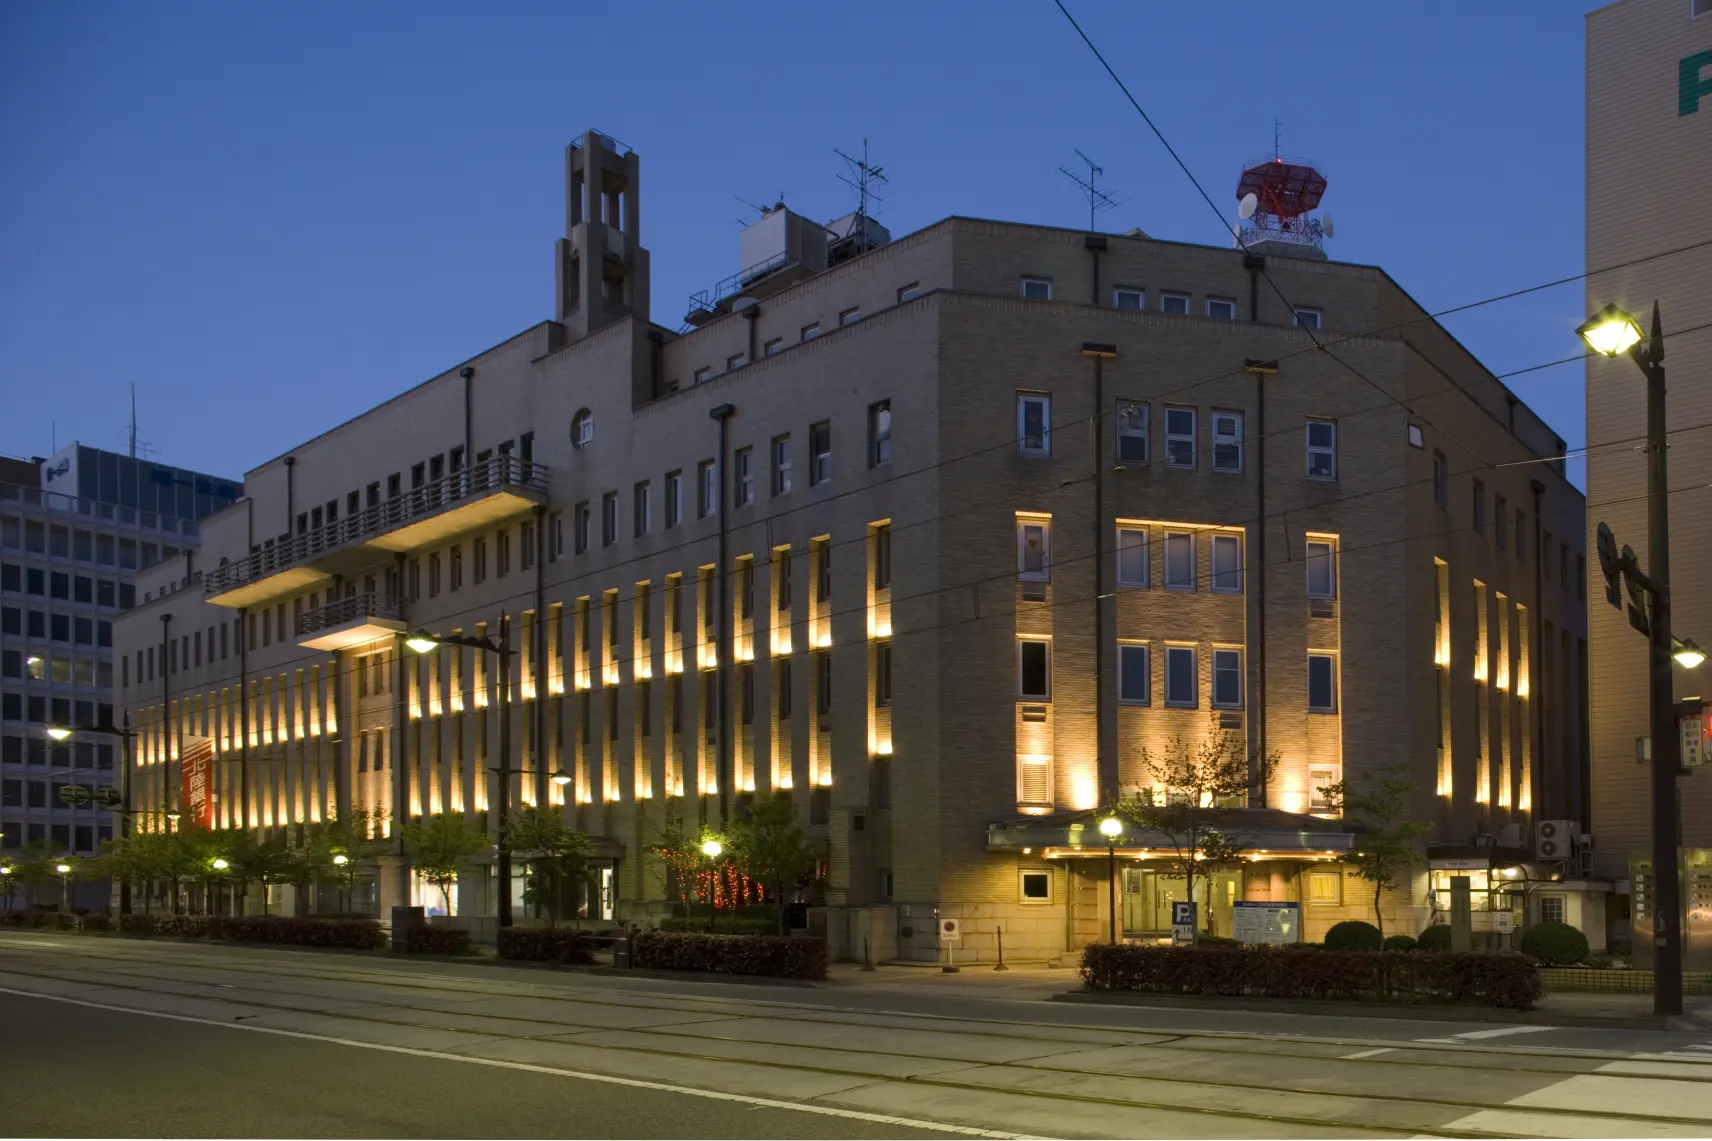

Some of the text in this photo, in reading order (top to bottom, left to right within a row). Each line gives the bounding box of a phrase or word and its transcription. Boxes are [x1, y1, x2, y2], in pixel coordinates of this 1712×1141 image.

[188, 758, 206, 823] 北陸銀行
[1176, 903, 1190, 922] P
